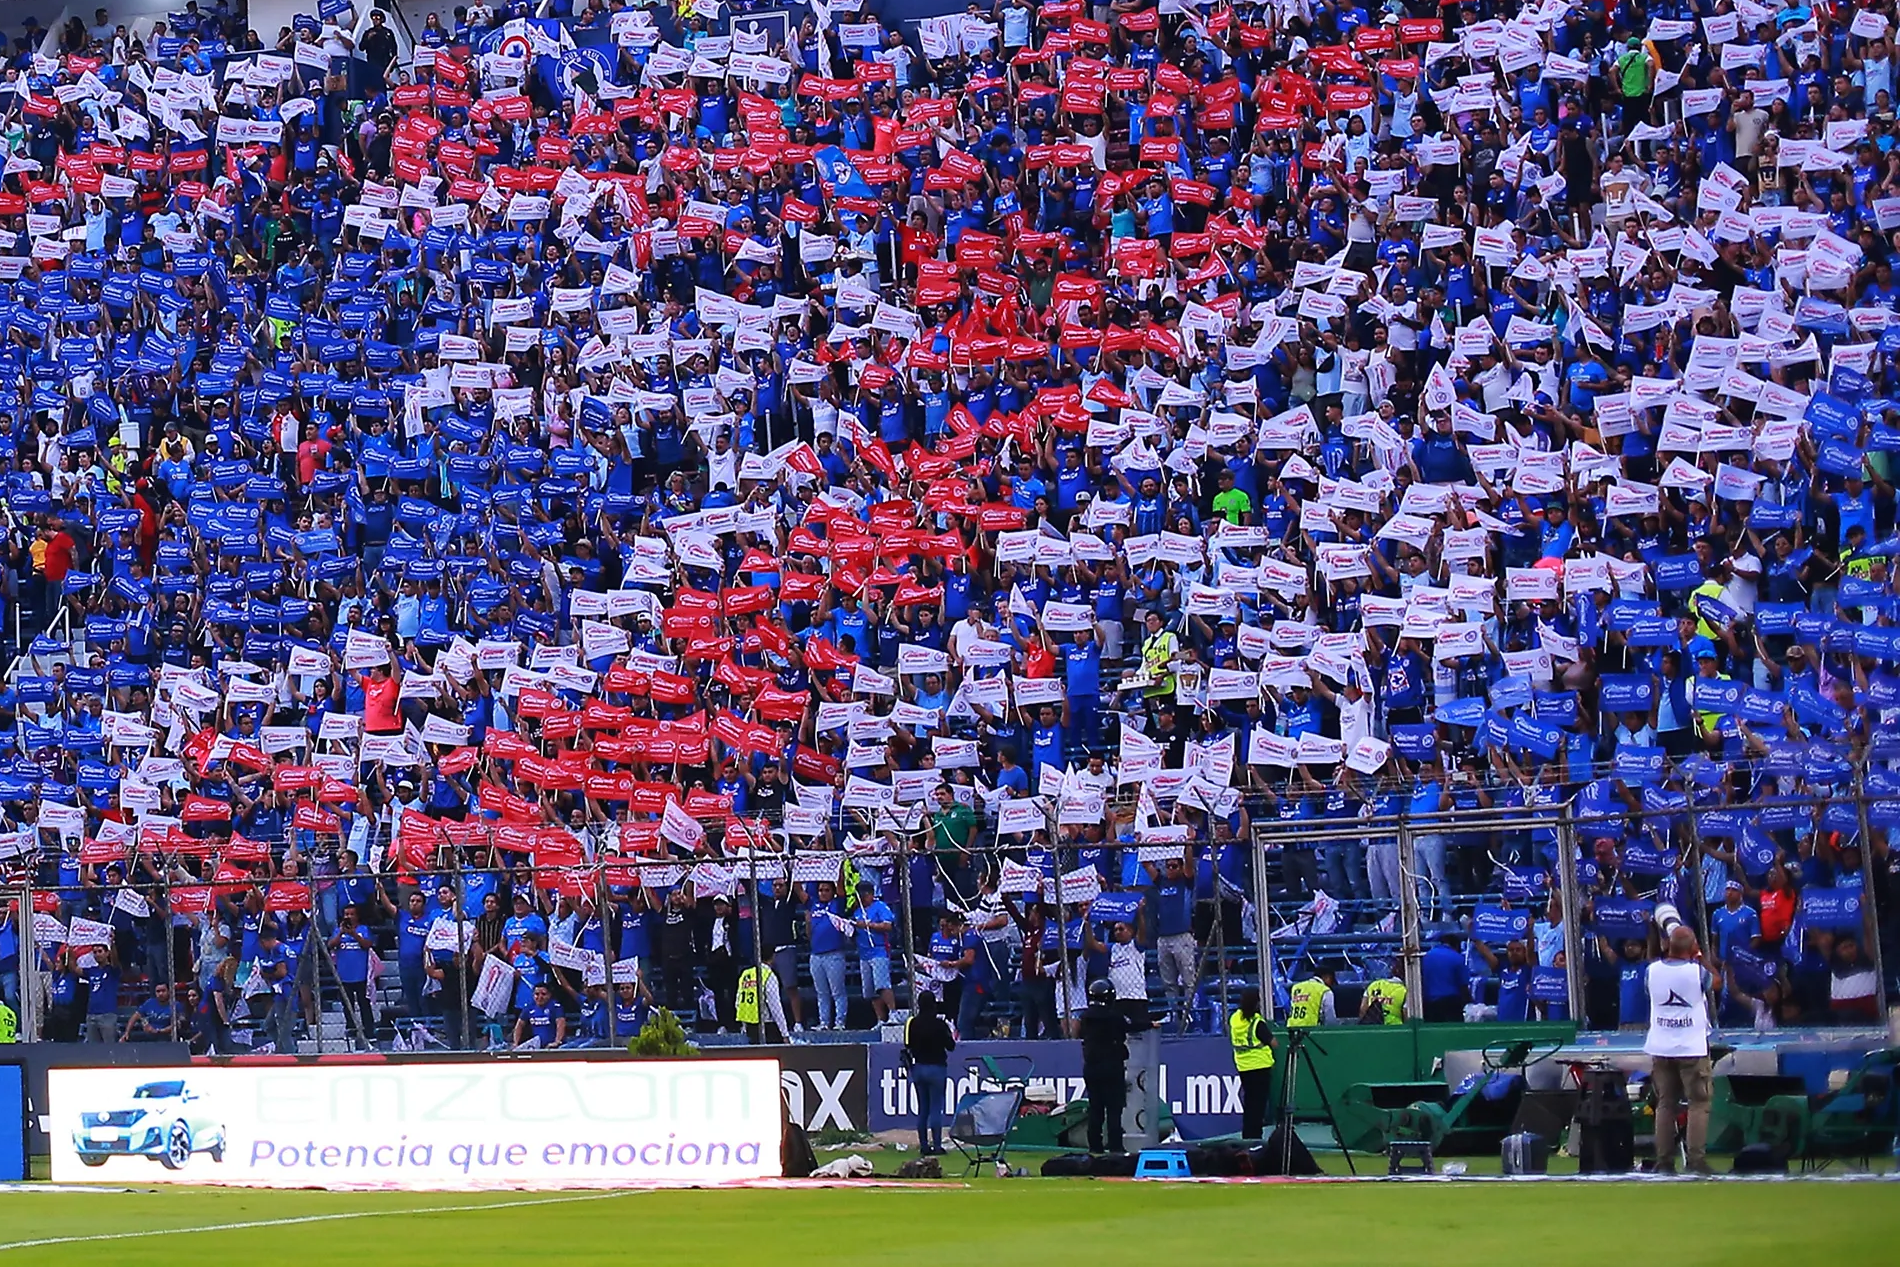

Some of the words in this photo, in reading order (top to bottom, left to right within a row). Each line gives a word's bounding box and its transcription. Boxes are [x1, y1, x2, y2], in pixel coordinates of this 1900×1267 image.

[740, 991, 754, 1005] 13
[249, 1133, 433, 1169] Potencia
[448, 1139, 528, 1175] que
[541, 1132, 762, 1167] emociona
